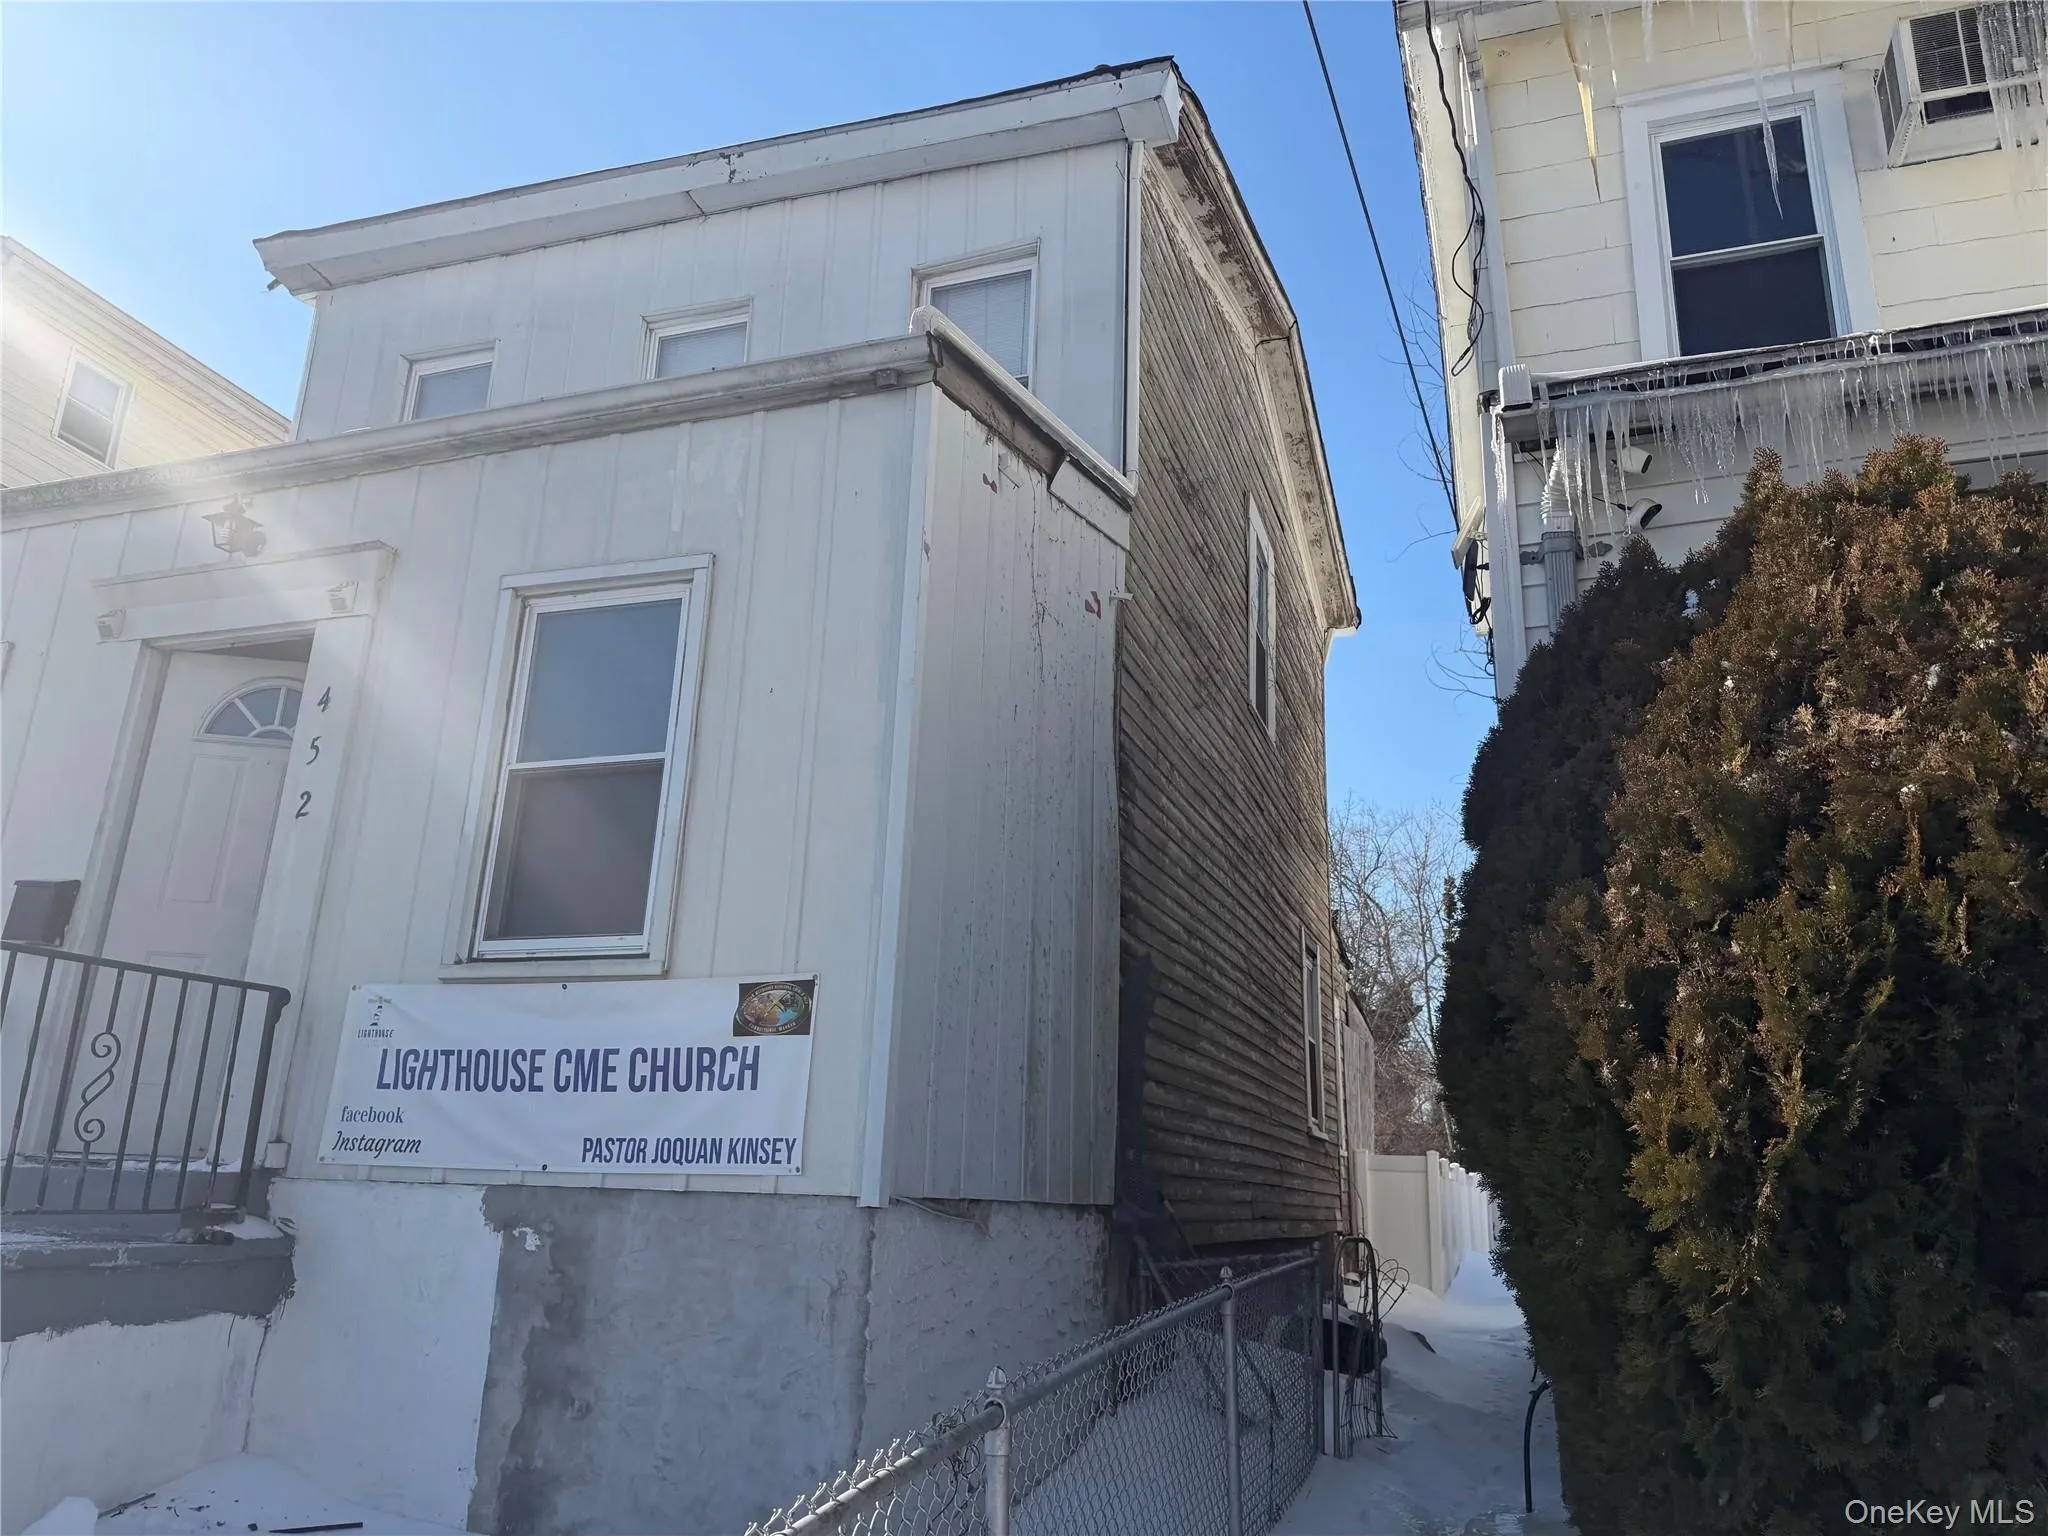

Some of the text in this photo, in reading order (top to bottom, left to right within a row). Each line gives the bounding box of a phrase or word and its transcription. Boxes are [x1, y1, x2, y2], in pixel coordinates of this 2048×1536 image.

[357, 1028, 395, 1039] LIGHTHOUSE
[376, 1044, 761, 1093] LIGHTHOUSE CME CHURCH
[340, 1105, 404, 1124] facebook
[331, 1130, 422, 1159] Instagram
[581, 1137, 797, 1166] PASTOR JOQUAN KINSEY
